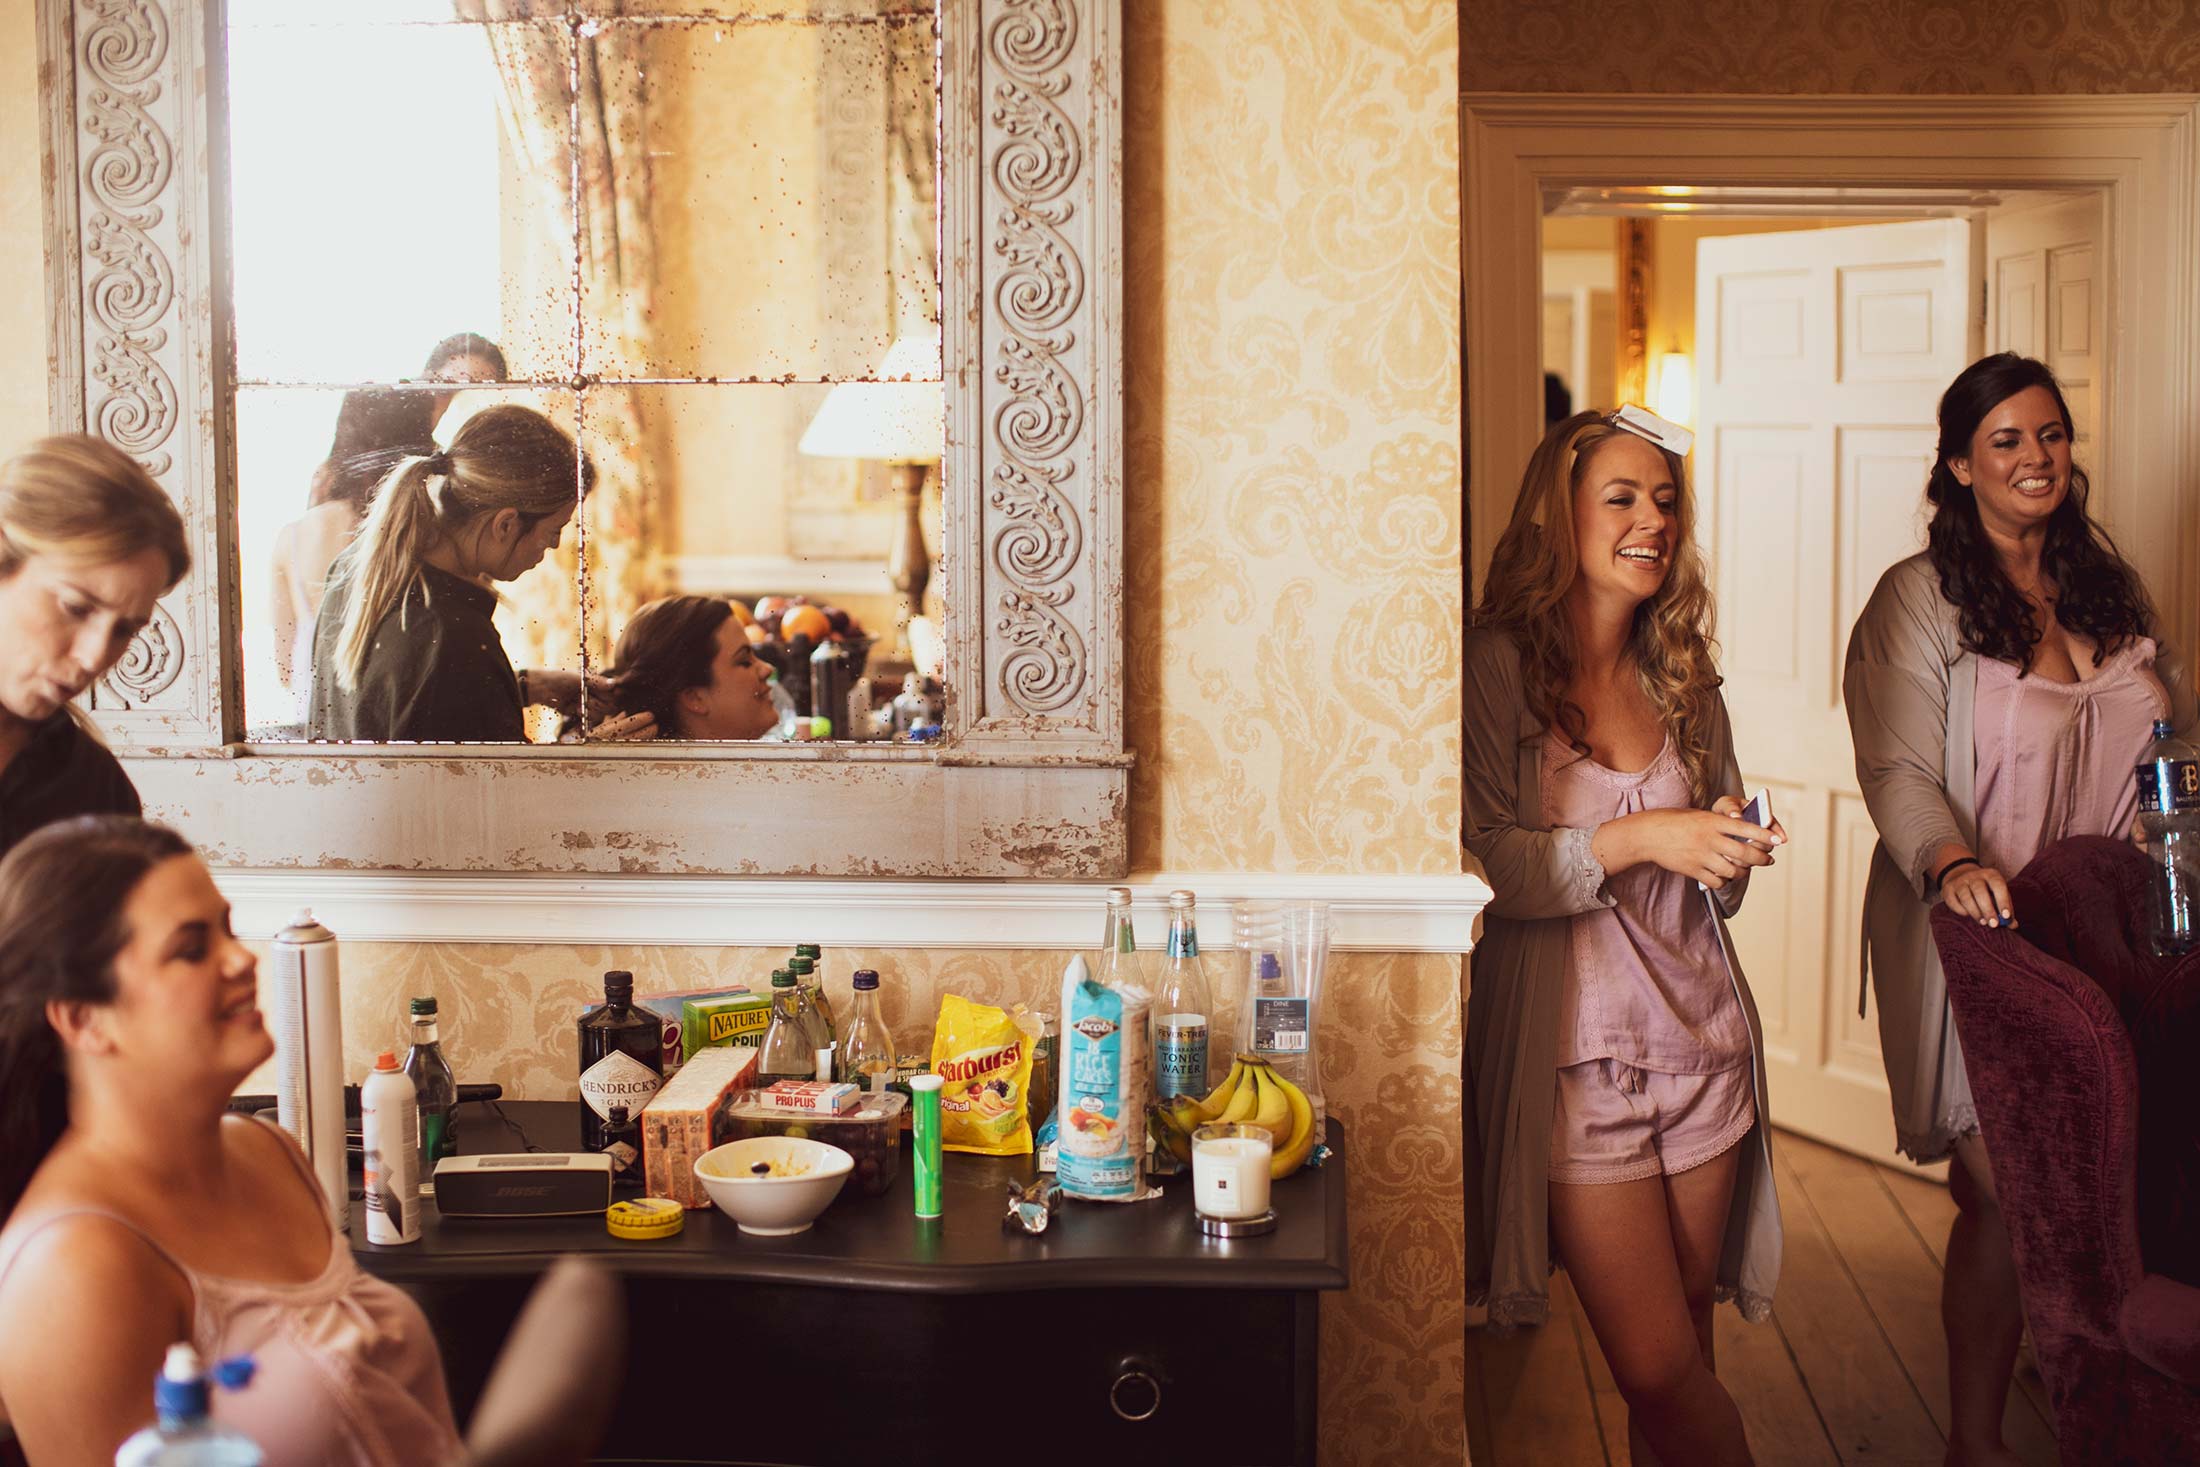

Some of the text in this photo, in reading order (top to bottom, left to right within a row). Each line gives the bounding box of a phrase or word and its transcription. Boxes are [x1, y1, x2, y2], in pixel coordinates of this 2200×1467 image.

[714, 1010, 764, 1037] NATURE
[937, 1041, 1021, 1083] Starburst
[1075, 1052, 1110, 1073] RICE
[1162, 1052, 1200, 1063] TONIC
[1161, 1063, 1201, 1074] WATER
[583, 1078, 658, 1094] HENDRICK'S
[607, 1098, 632, 1107] GIN
[775, 1095, 816, 1109] PRO PLUS
[940, 1099, 970, 1112] riginal
